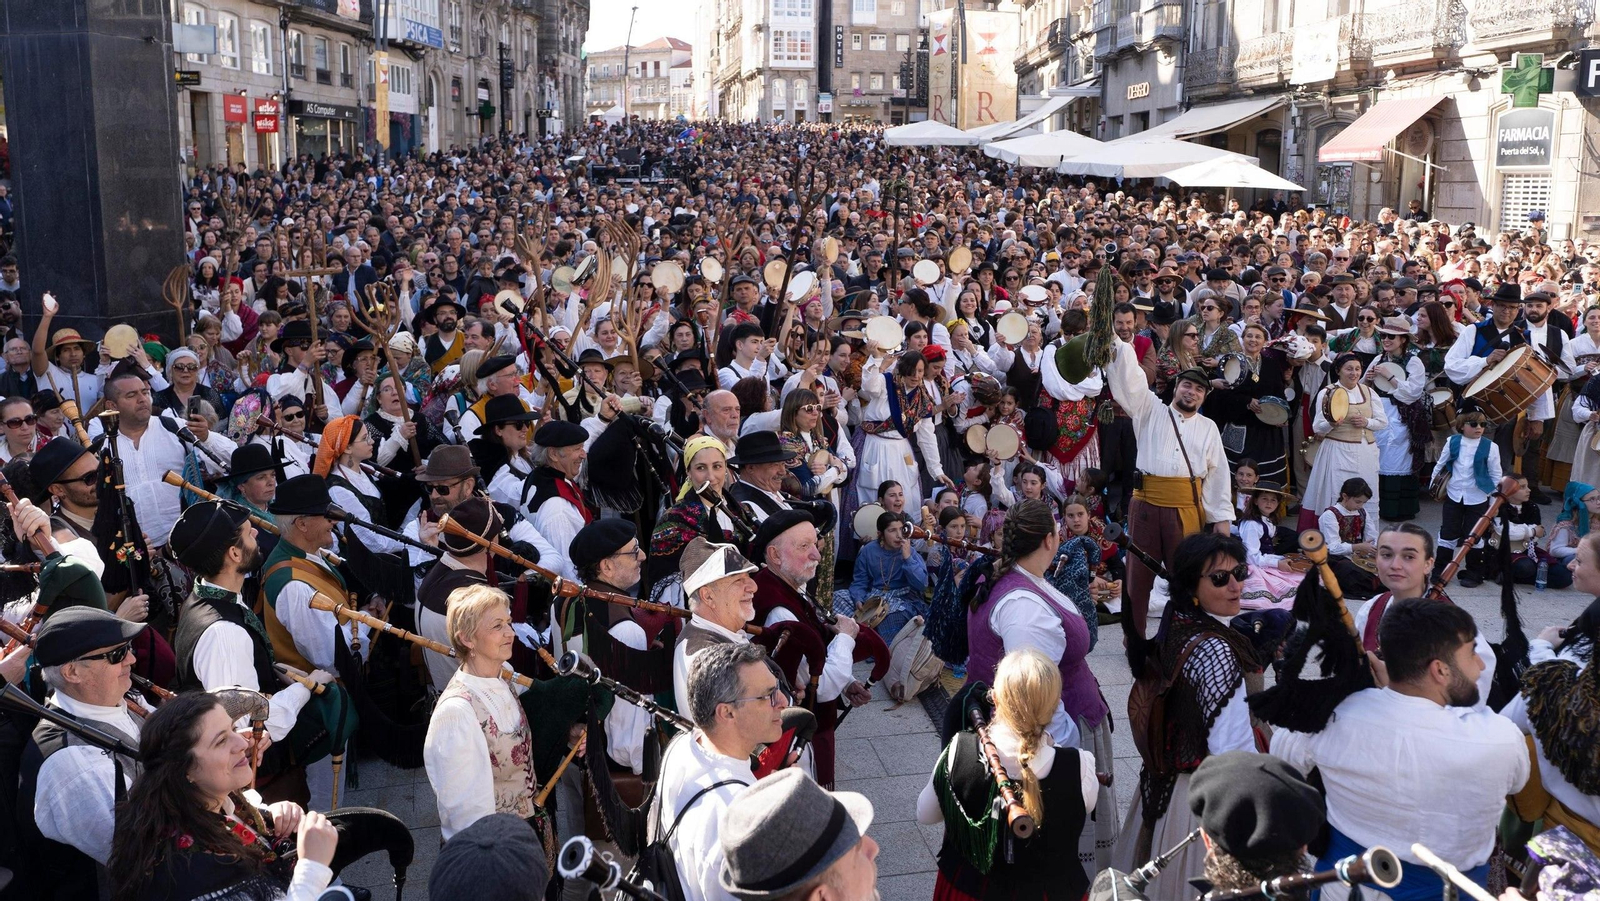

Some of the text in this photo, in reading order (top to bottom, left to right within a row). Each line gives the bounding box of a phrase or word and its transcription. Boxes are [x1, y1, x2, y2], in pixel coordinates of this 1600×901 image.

[307, 103, 313, 113] AS
[314, 104, 336, 116] Computer
[933, 94, 947, 121] R
[976, 91, 999, 122] R
[1499, 126, 1550, 142] FARMACIA
[1501, 147, 1519, 155] Puerta
[1530, 146, 1539, 156] Sol,
[1540, 148, 1545, 156] 4
